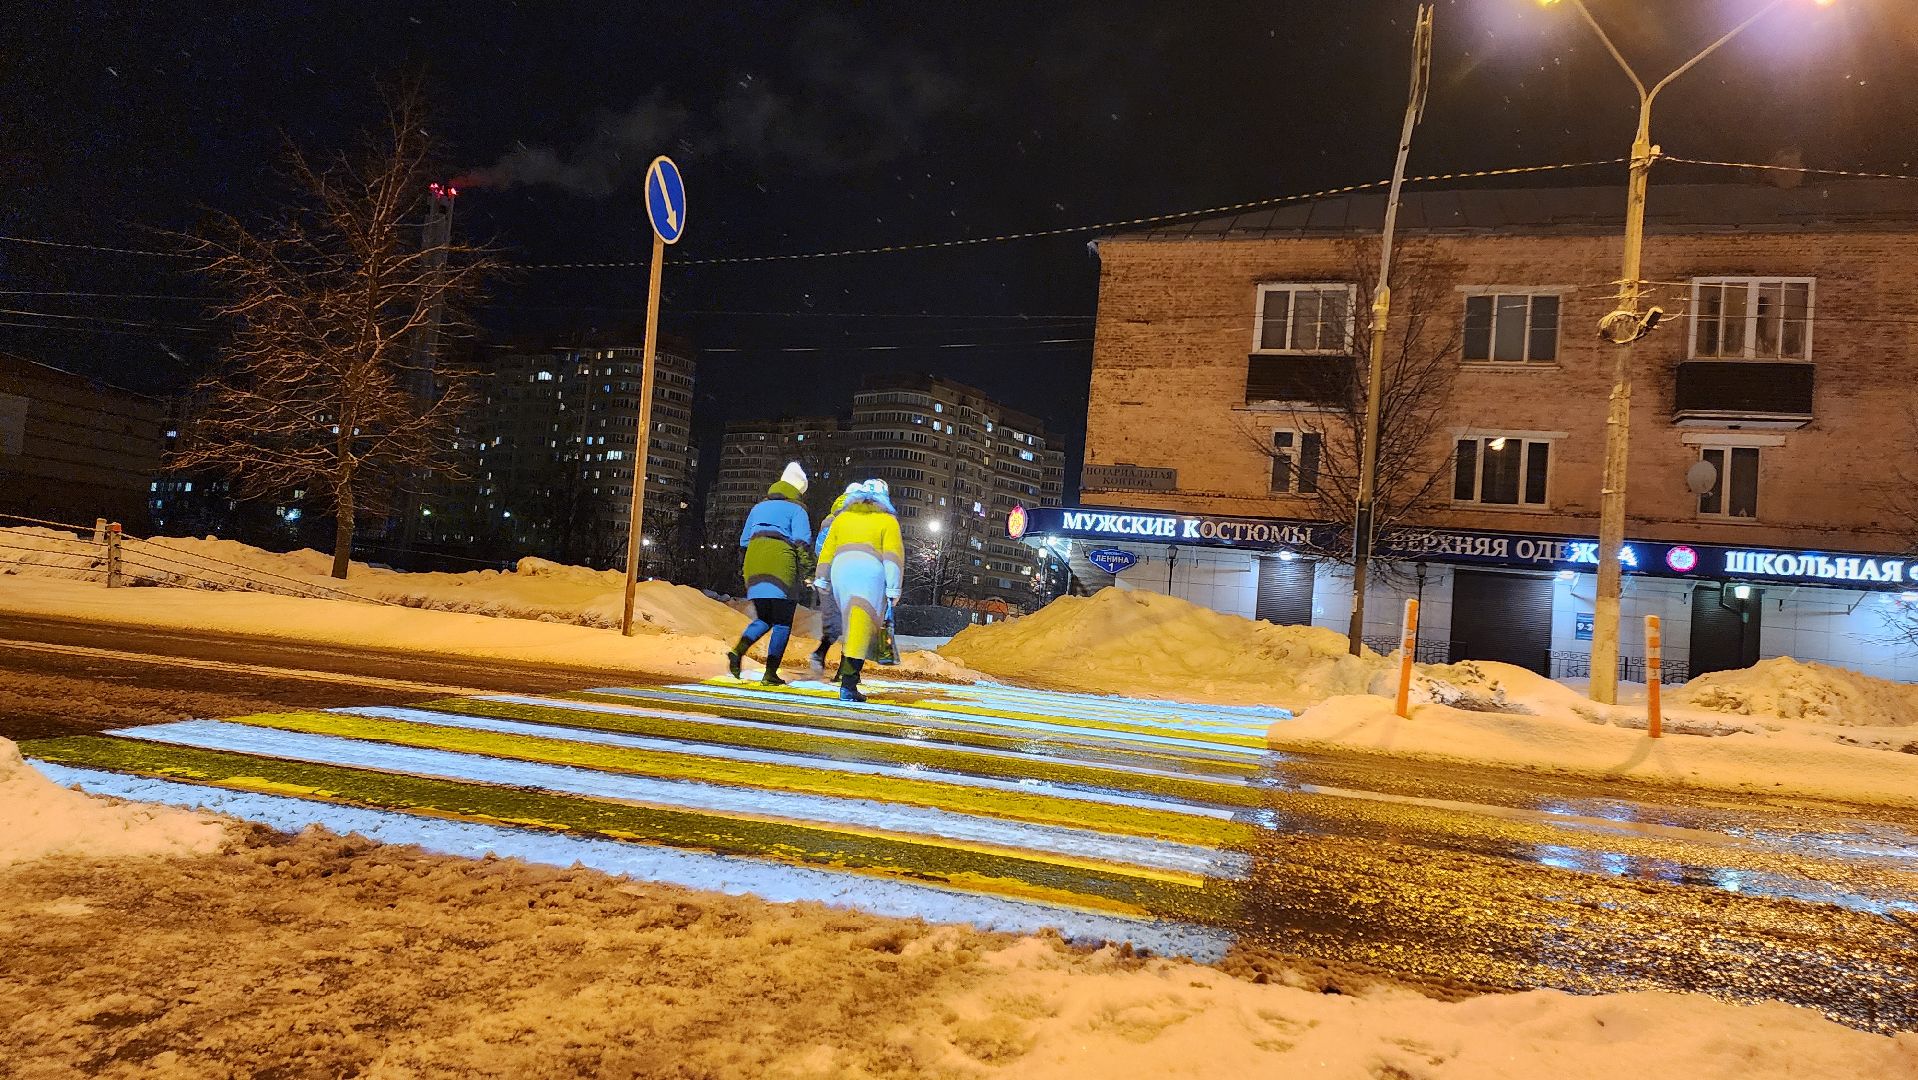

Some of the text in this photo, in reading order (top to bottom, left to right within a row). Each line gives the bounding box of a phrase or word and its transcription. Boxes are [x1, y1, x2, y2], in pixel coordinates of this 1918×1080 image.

[1086, 467, 1174, 480] НОТАРИАЛЬНАЯ
[1103, 477, 1153, 488] КОНТОРА
[1062, 512, 1314, 545] МУЖСКИЕ КОСТЮМЫ
[1095, 555, 1130, 564] ЛЕНИНА
[1516, 540, 1638, 567] ОДЕЖА
[1108, 563, 1114, 571] 1
[1724, 551, 1905, 582] ШКОЛЬНАЯ
[1577, 622, 1593, 632] 9-2
